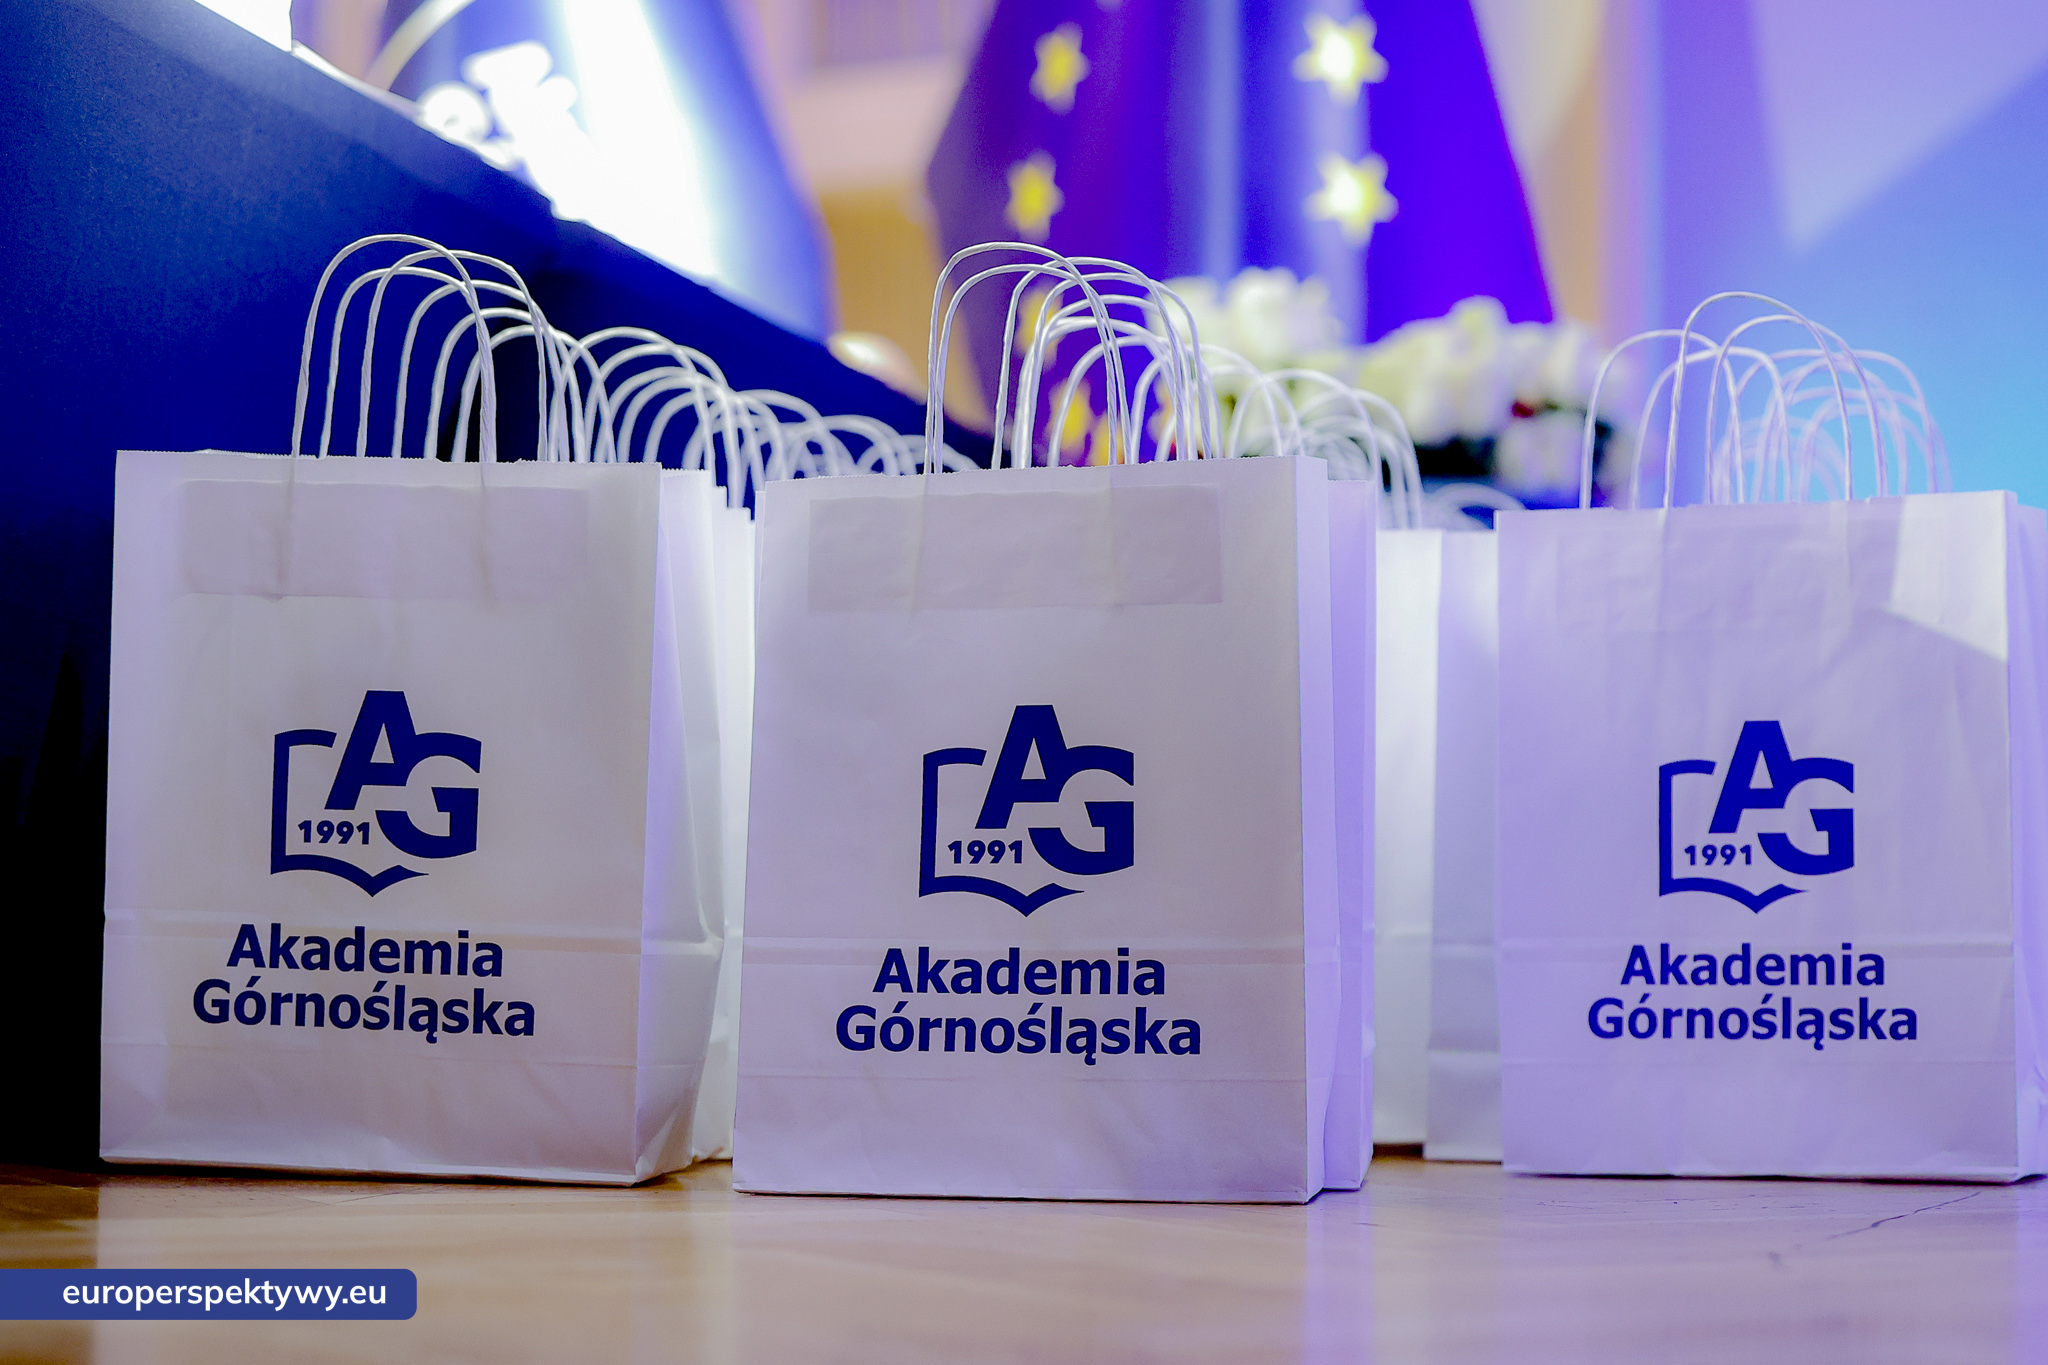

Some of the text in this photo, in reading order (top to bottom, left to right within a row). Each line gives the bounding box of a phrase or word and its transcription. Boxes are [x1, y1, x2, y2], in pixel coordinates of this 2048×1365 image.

[324, 690, 481, 859] AG
[975, 705, 1134, 875] AG
[1709, 721, 1854, 875] AG
[298, 819, 370, 845] 1991
[947, 839, 1023, 865] 1991
[1684, 843, 1752, 866] 1991
[227, 922, 503, 978] Akademia
[873, 946, 1166, 996] Akademia
[1620, 942, 1885, 987] Akademia
[193, 975, 535, 1045] Górnośląska
[835, 1000, 1201, 1066] Górnośląska
[1587, 992, 1917, 1051] Górnośląska
